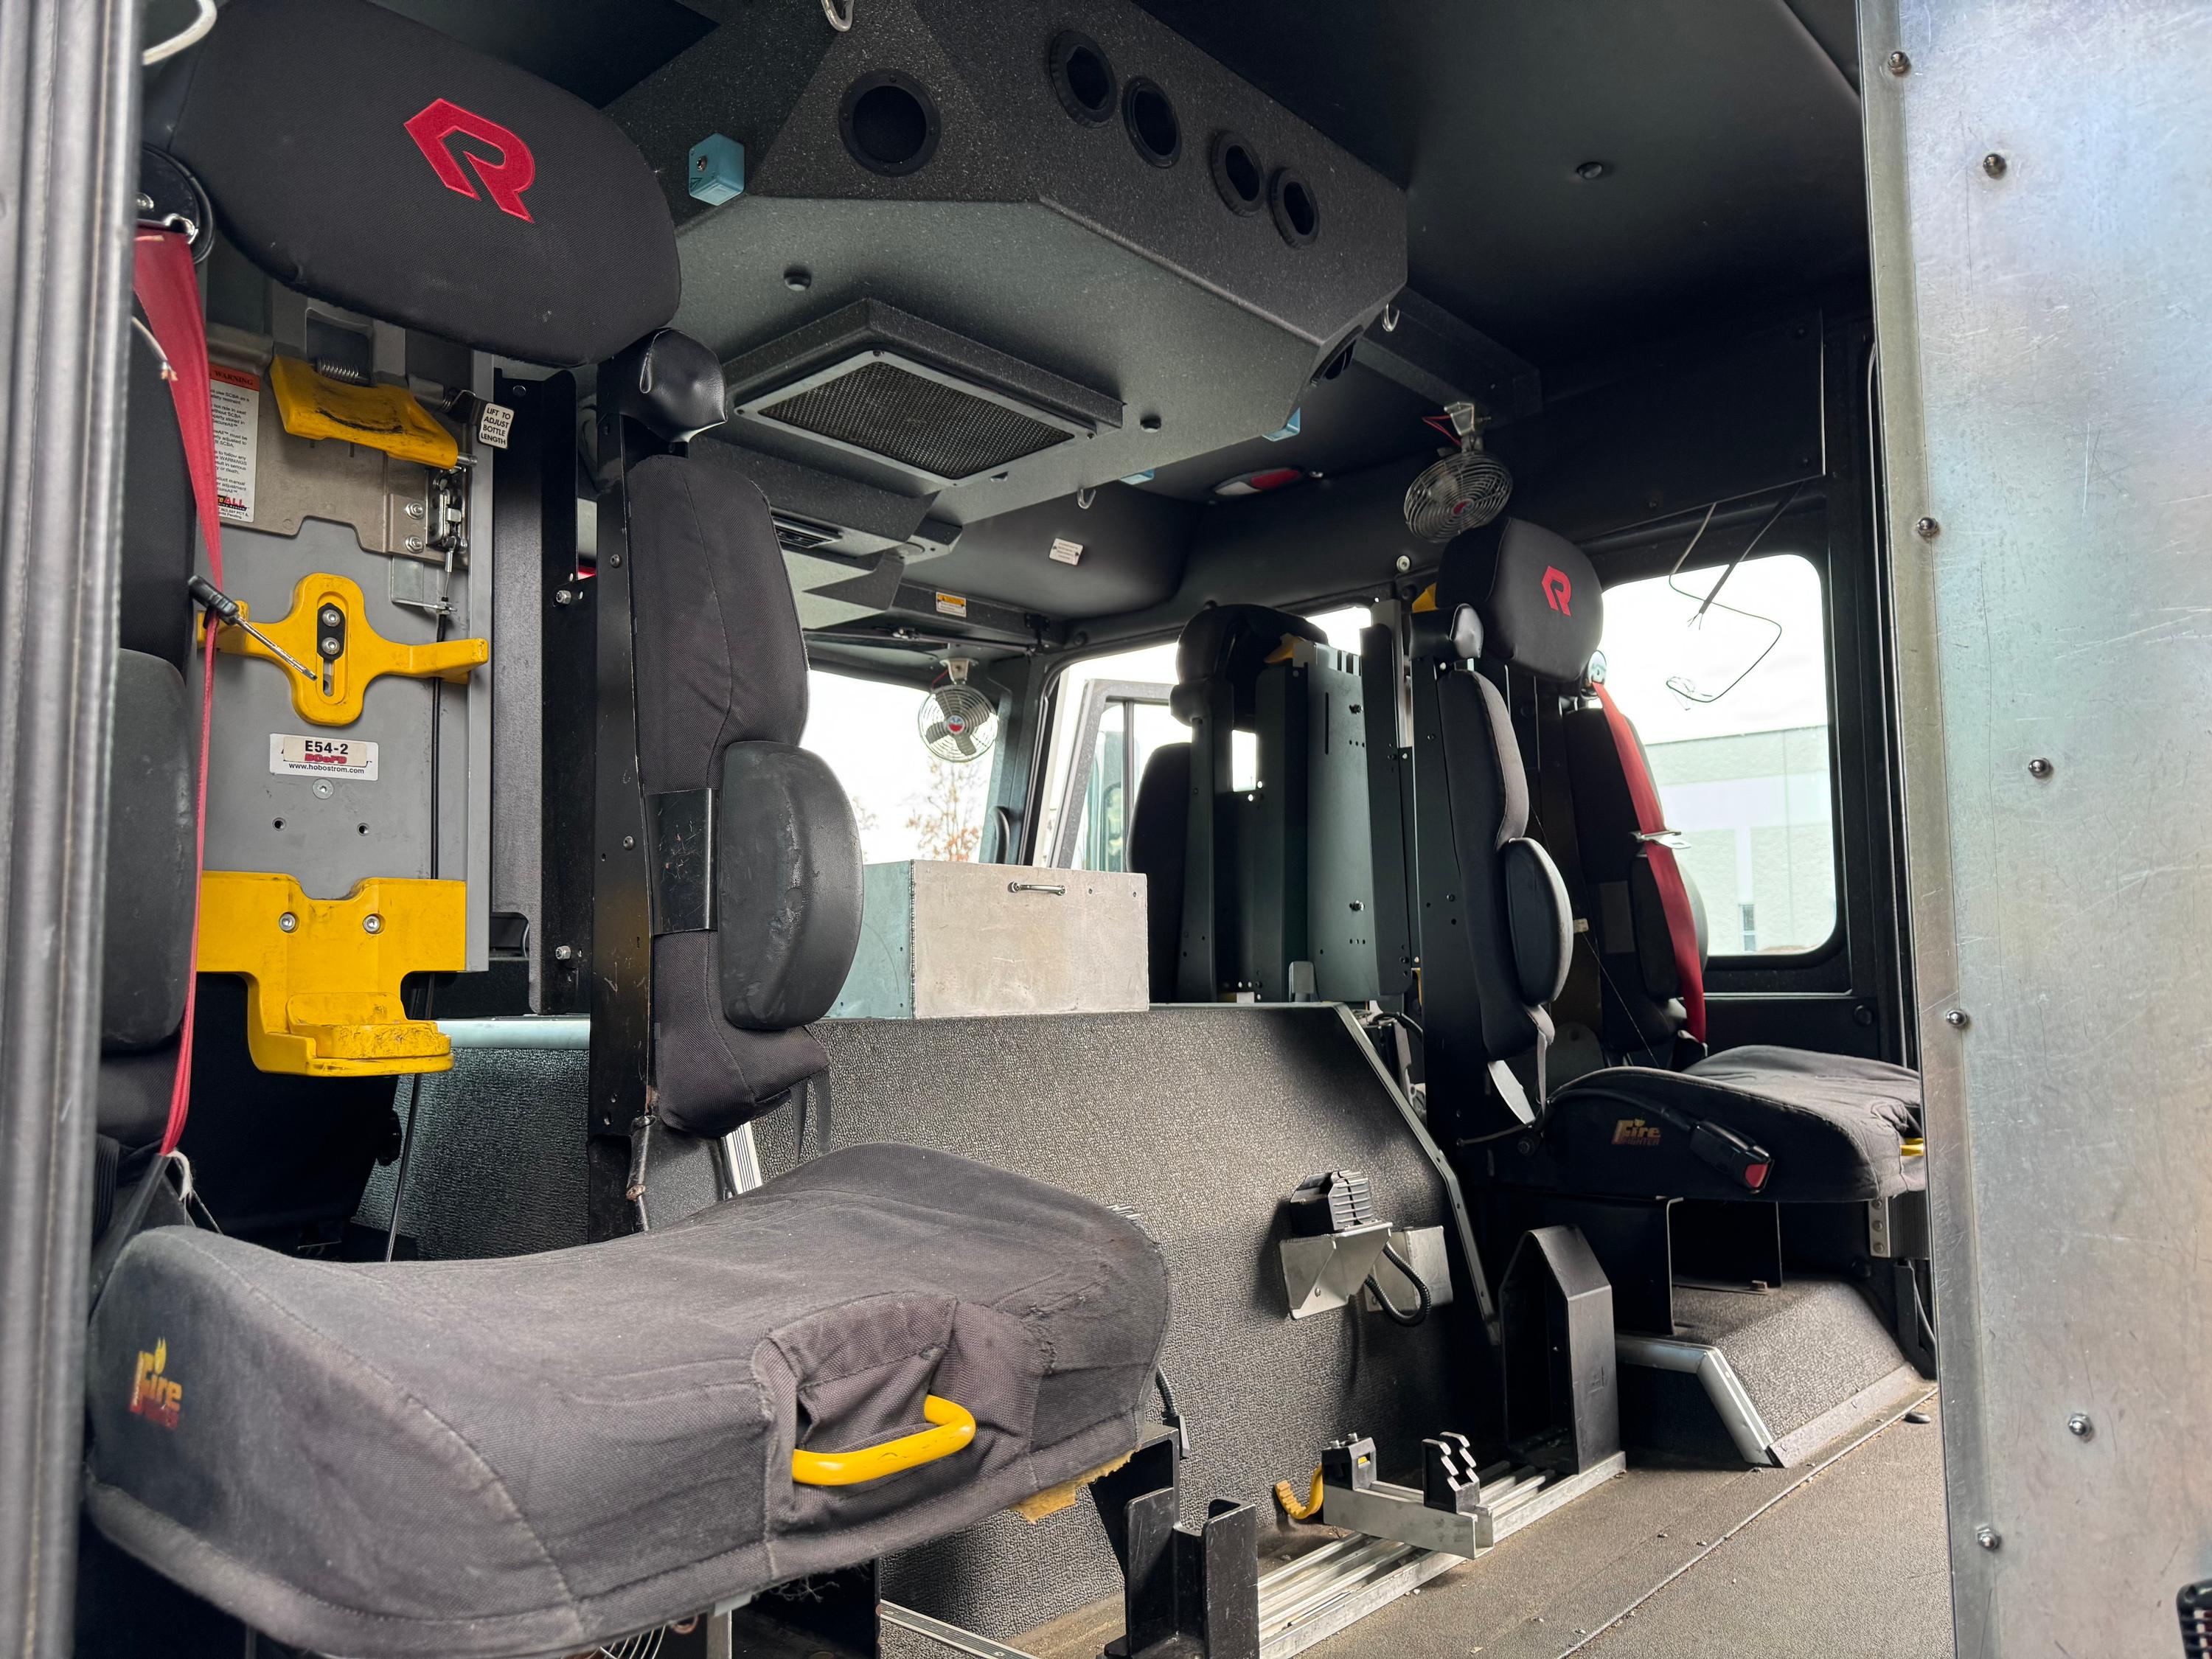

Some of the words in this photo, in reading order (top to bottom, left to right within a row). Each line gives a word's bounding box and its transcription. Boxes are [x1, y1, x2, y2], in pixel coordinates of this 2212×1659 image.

[215, 370, 254, 385] WARNING
[487, 407, 499, 416] LIFT
[502, 411, 511, 420] TO
[484, 416, 509, 428] ADJUST
[483, 424, 506, 437] BOTTLE
[481, 433, 506, 445] LENGTH
[220, 456, 247, 465] WARNINGS
[305, 740, 349, 755] E54-2
[289, 762, 364, 774] www.hobostrom.com
[1611, 1118, 1661, 1144] Fire
[130, 1338, 183, 1413] Fire
